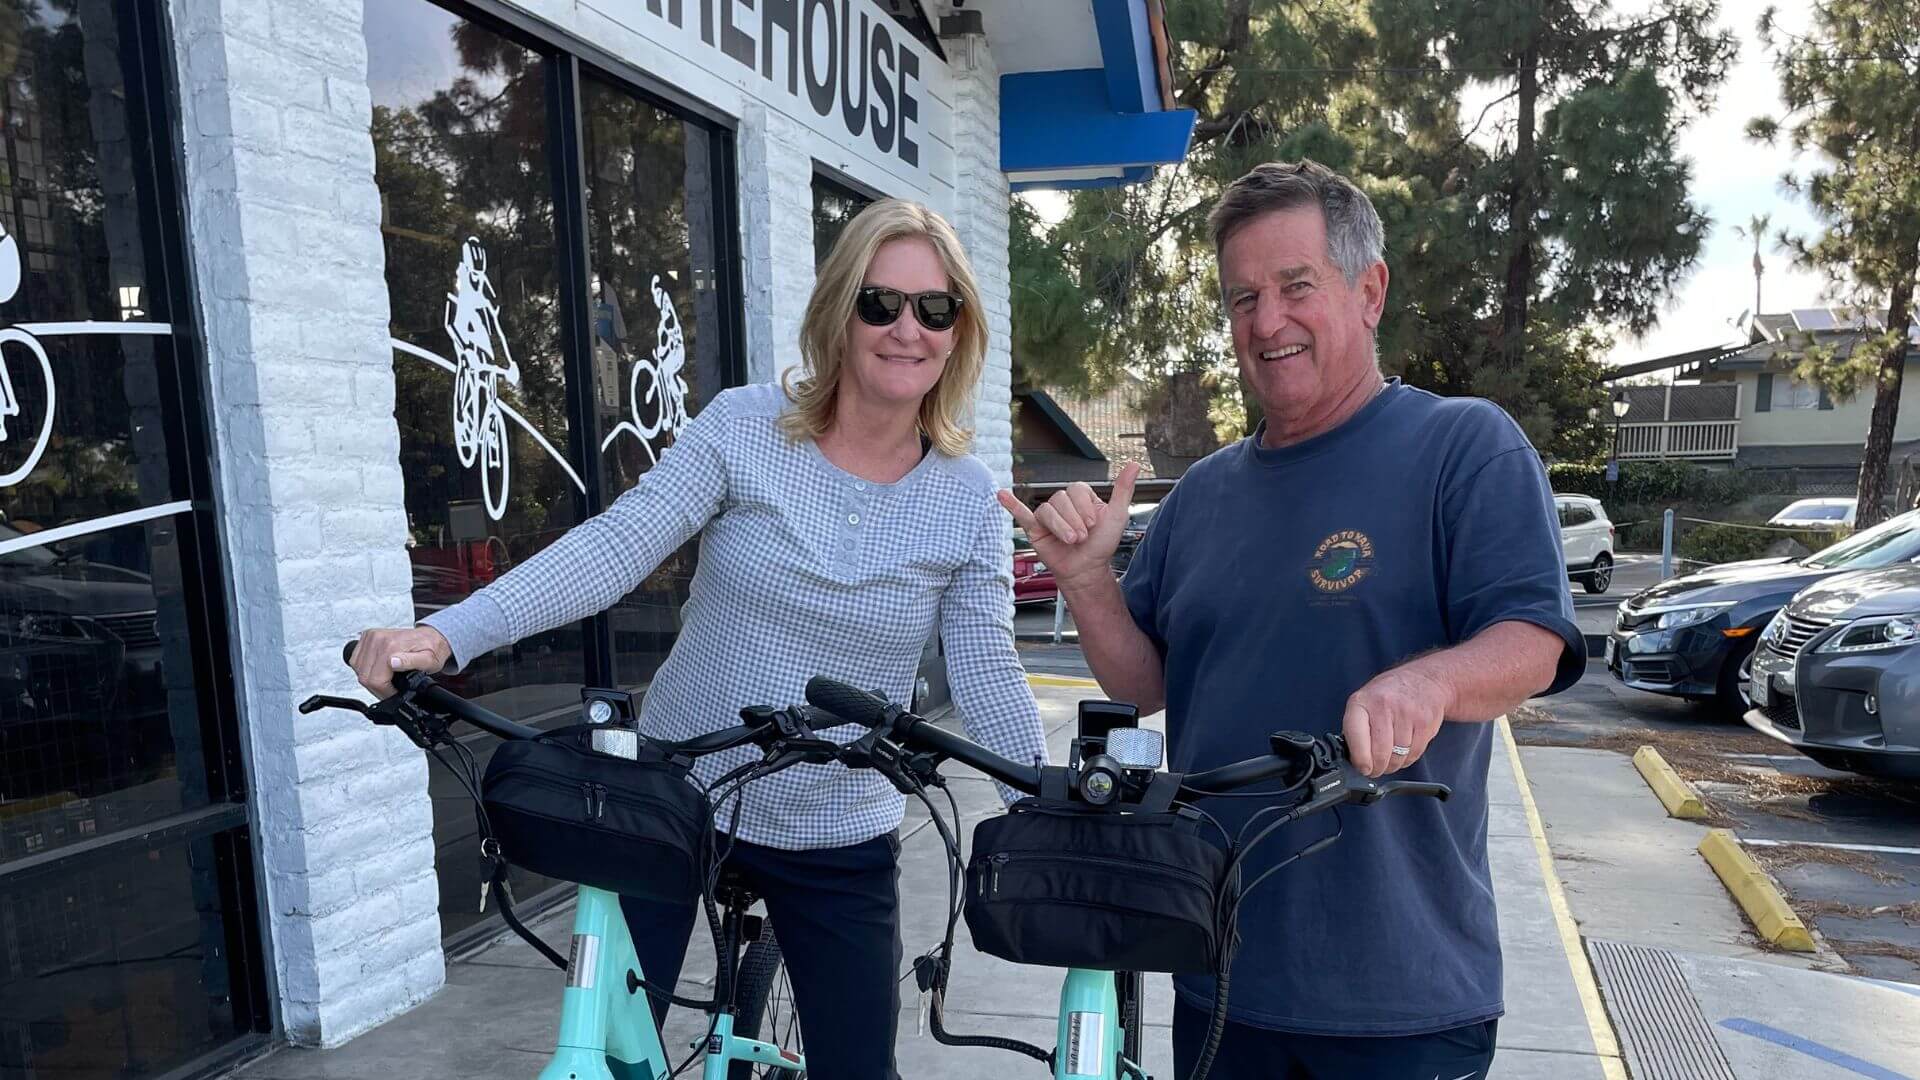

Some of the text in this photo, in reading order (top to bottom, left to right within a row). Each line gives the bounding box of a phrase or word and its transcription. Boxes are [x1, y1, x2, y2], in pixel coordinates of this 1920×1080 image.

[1314, 534, 1339, 558] ROAD
[1341, 531, 1354, 539] TO
[1311, 569, 1362, 590] SURVIVOR
